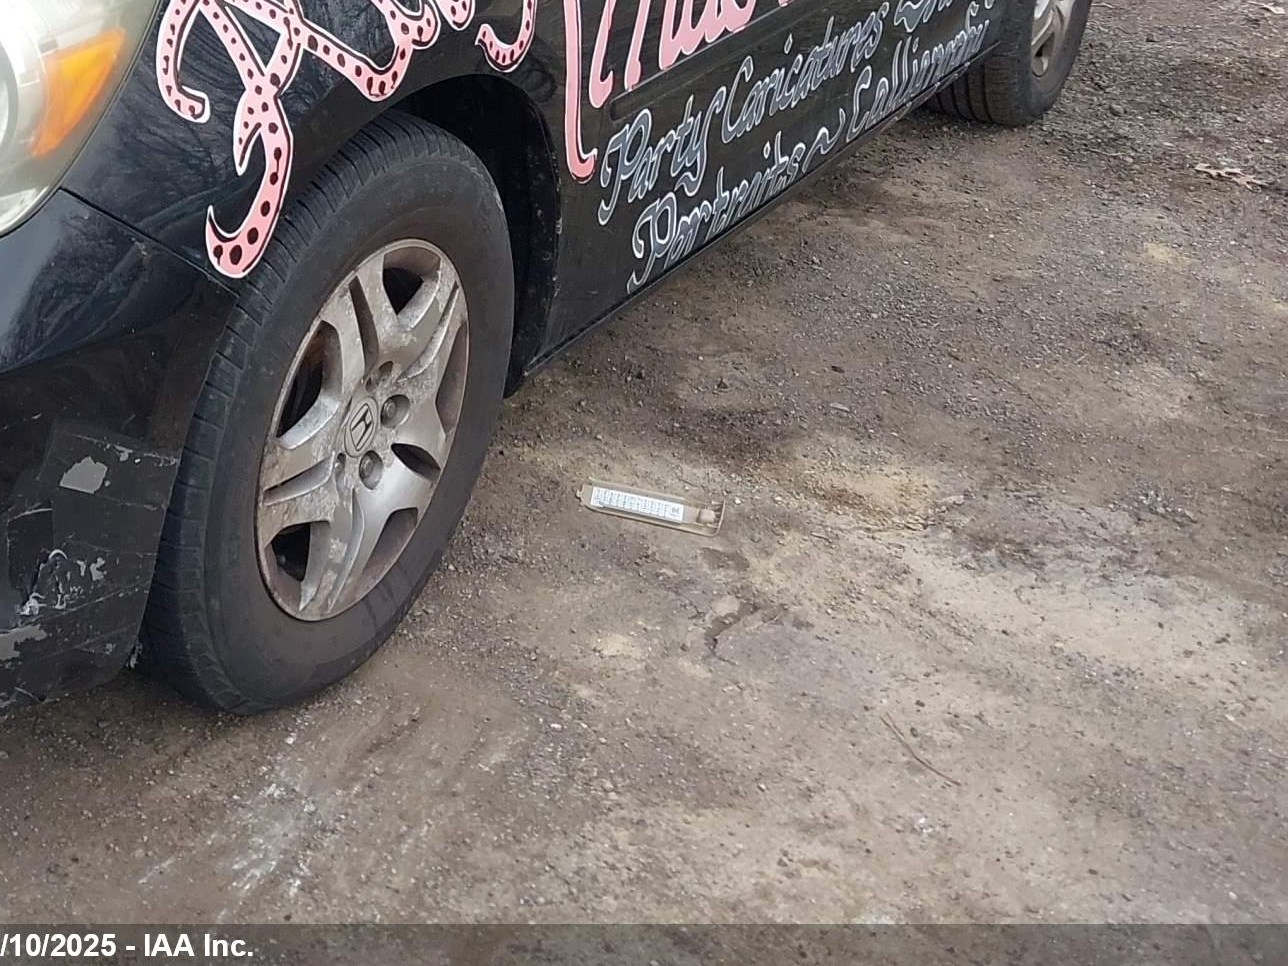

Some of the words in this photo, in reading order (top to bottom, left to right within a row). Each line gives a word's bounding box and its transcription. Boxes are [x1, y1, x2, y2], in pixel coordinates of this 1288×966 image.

[597, 85, 728, 226] Party
[720, 1, 890, 144] Caricatures
[626, 130, 806, 295] Portraits
